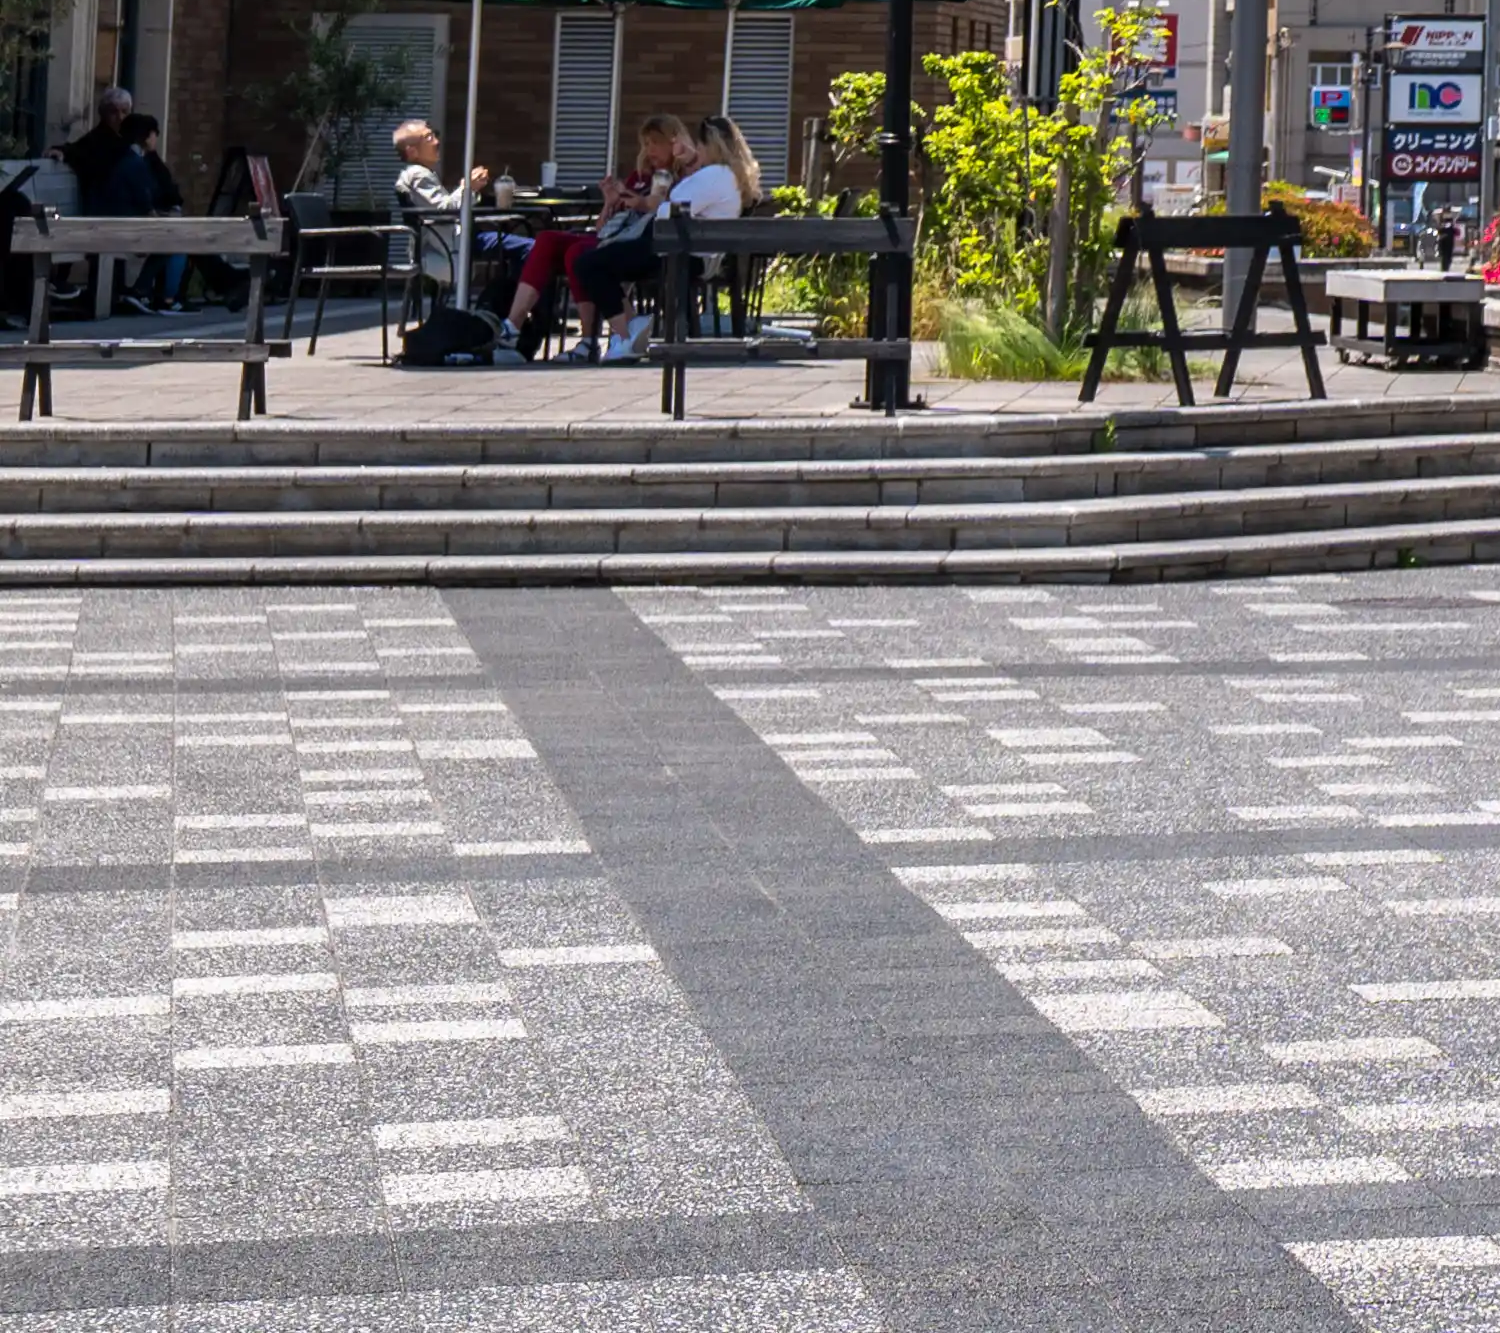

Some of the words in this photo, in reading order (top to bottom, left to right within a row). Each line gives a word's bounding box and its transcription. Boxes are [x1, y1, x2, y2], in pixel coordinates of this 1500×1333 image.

[1321, 90, 1343, 106] P
[1393, 133, 1477, 151] クリーニング
[1415, 155, 1478, 174] コインランドリー
